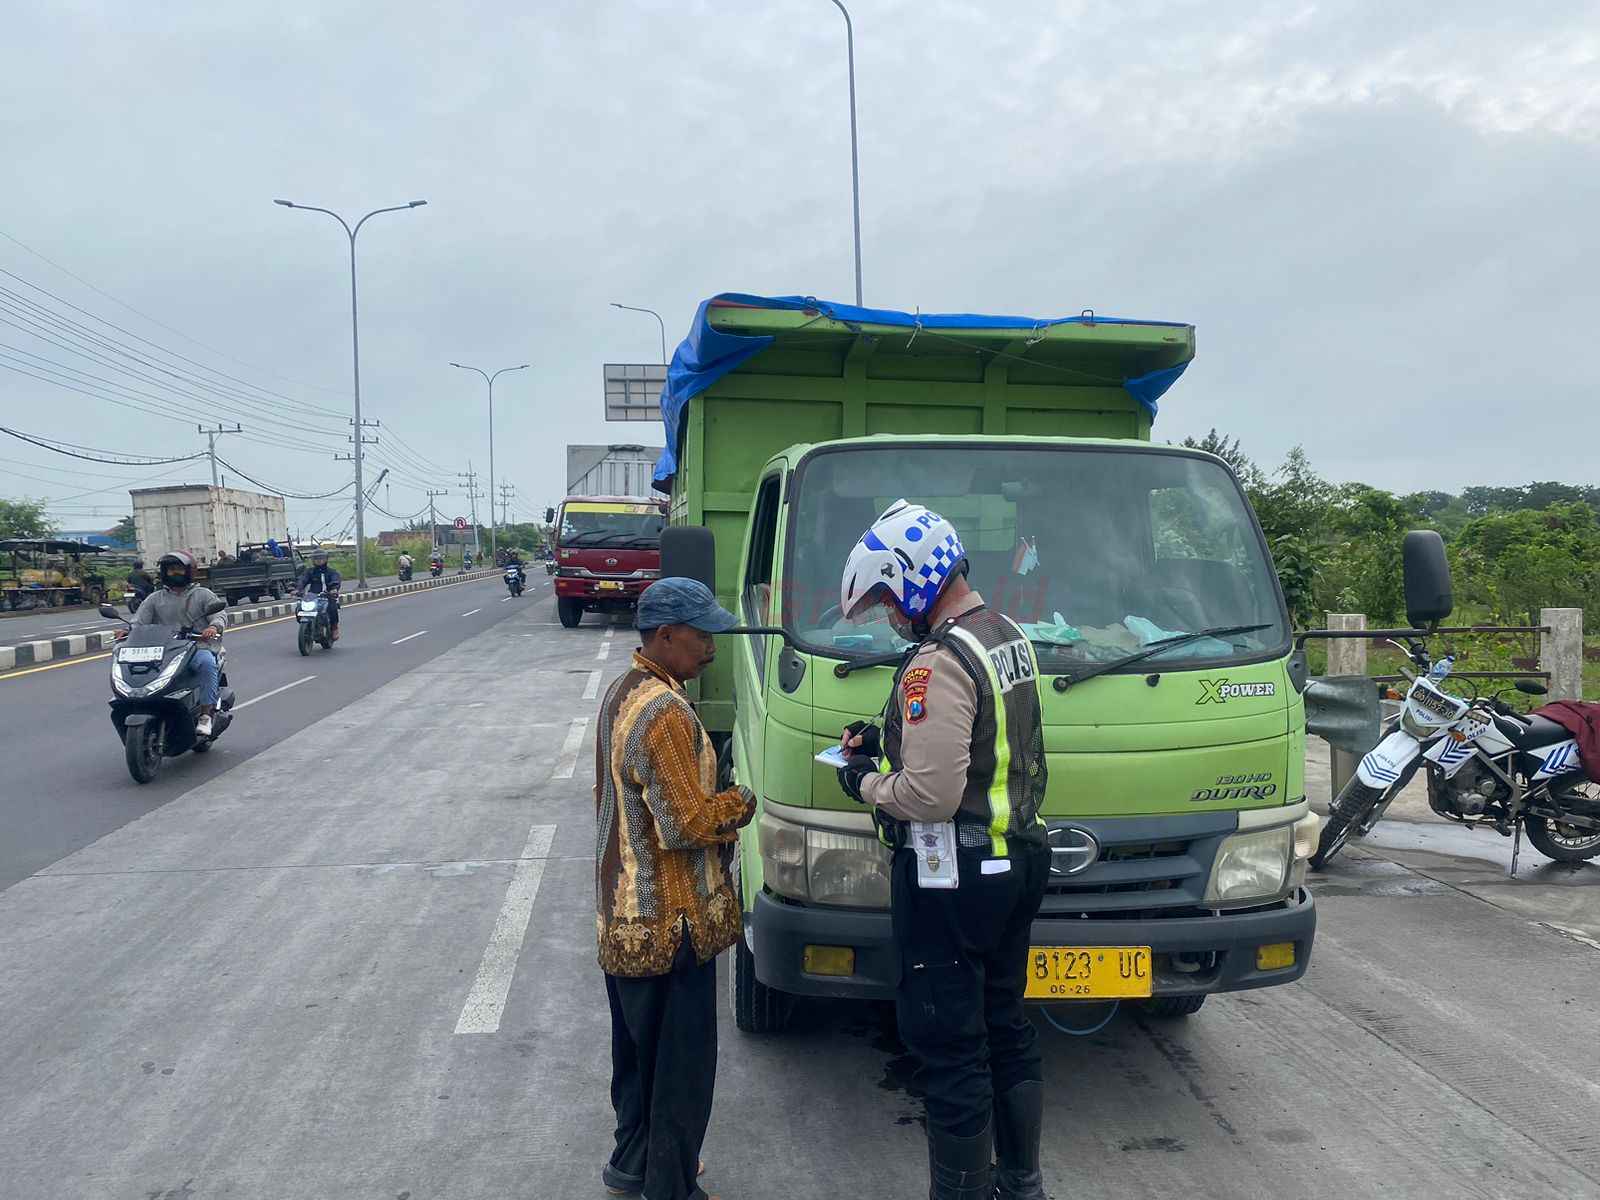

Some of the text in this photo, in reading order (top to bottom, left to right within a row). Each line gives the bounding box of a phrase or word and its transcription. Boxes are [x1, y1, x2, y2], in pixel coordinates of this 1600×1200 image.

[1467, 727, 1486, 740] OLISI
[1190, 784, 1277, 801] DUTRO
[1118, 951, 1146, 978] UC
